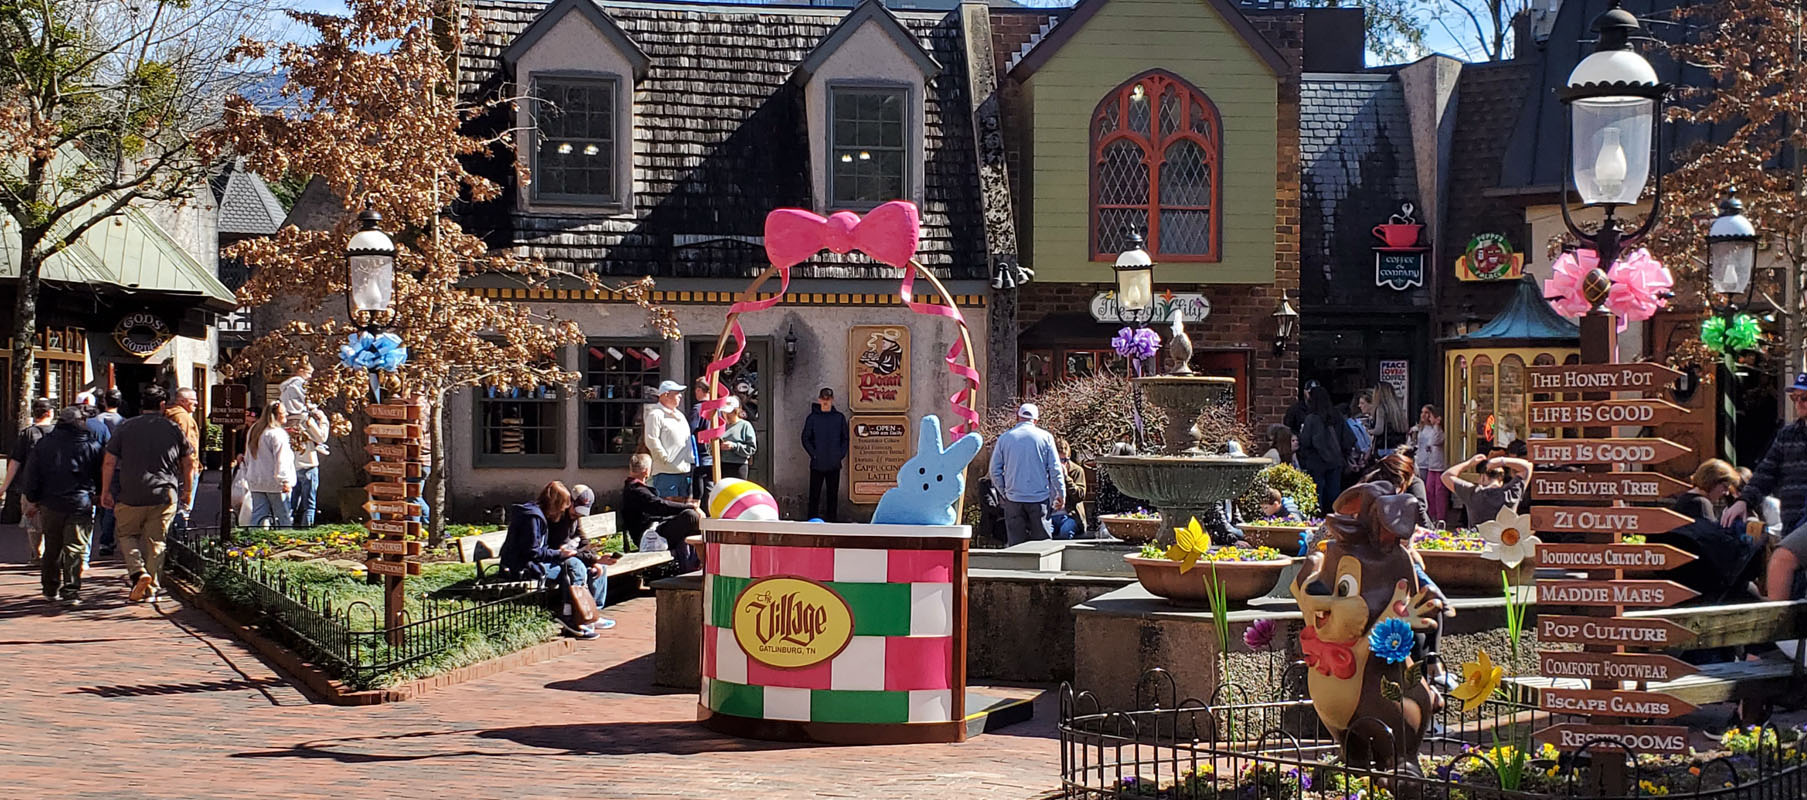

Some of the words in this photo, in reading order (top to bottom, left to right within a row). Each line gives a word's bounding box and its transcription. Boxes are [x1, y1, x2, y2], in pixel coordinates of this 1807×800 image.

[1476, 233, 1504, 241] PEPPER
[1386, 256, 1415, 264] COFFEE
[1380, 269, 1420, 278] COMPANY
[1097, 298, 1126, 317] The
[122, 337, 163, 352] CORNER
[858, 373, 903, 388] Donut
[1531, 372, 1561, 388] THE
[1563, 371, 1618, 387] HONEY
[1622, 370, 1653, 386] POT
[860, 387, 898, 402] Friar
[1532, 407, 1571, 423] LIFE
[1575, 406, 1593, 422] IS
[1596, 405, 1654, 422] GOOD
[1533, 445, 1572, 461] LIFE
[1576, 445, 1593, 461] IS
[1597, 444, 1655, 461] GOOD
[854, 464, 901, 472] CAPPUCCIN
[1536, 479, 1566, 495] THE
[1568, 479, 1618, 495] SILVER
[1621, 480, 1660, 496] TREE
[1553, 511, 1574, 528] ZI
[1578, 512, 1638, 529] OLIVE
[1542, 549, 1602, 564] BOUDICCA'S
[1604, 549, 1643, 565] CELTIC
[1644, 551, 1665, 565] PUB
[754, 590, 772, 604] The
[1541, 585, 1609, 601] MADDIE
[1612, 586, 1664, 602] MAE'S
[745, 592, 827, 647] Village
[1543, 621, 1579, 638] POP
[1582, 623, 1667, 641] CULTURE
[759, 645, 804, 655] GATLINBURG,
[806, 647, 816, 655] TN
[1545, 658, 1600, 676] COMFORT
[1603, 660, 1668, 679] FOOTWEAR
[1545, 692, 1607, 711] ESCAPE
[1610, 696, 1670, 715] GAMES
[1560, 730, 1685, 750] RESTROOMS
